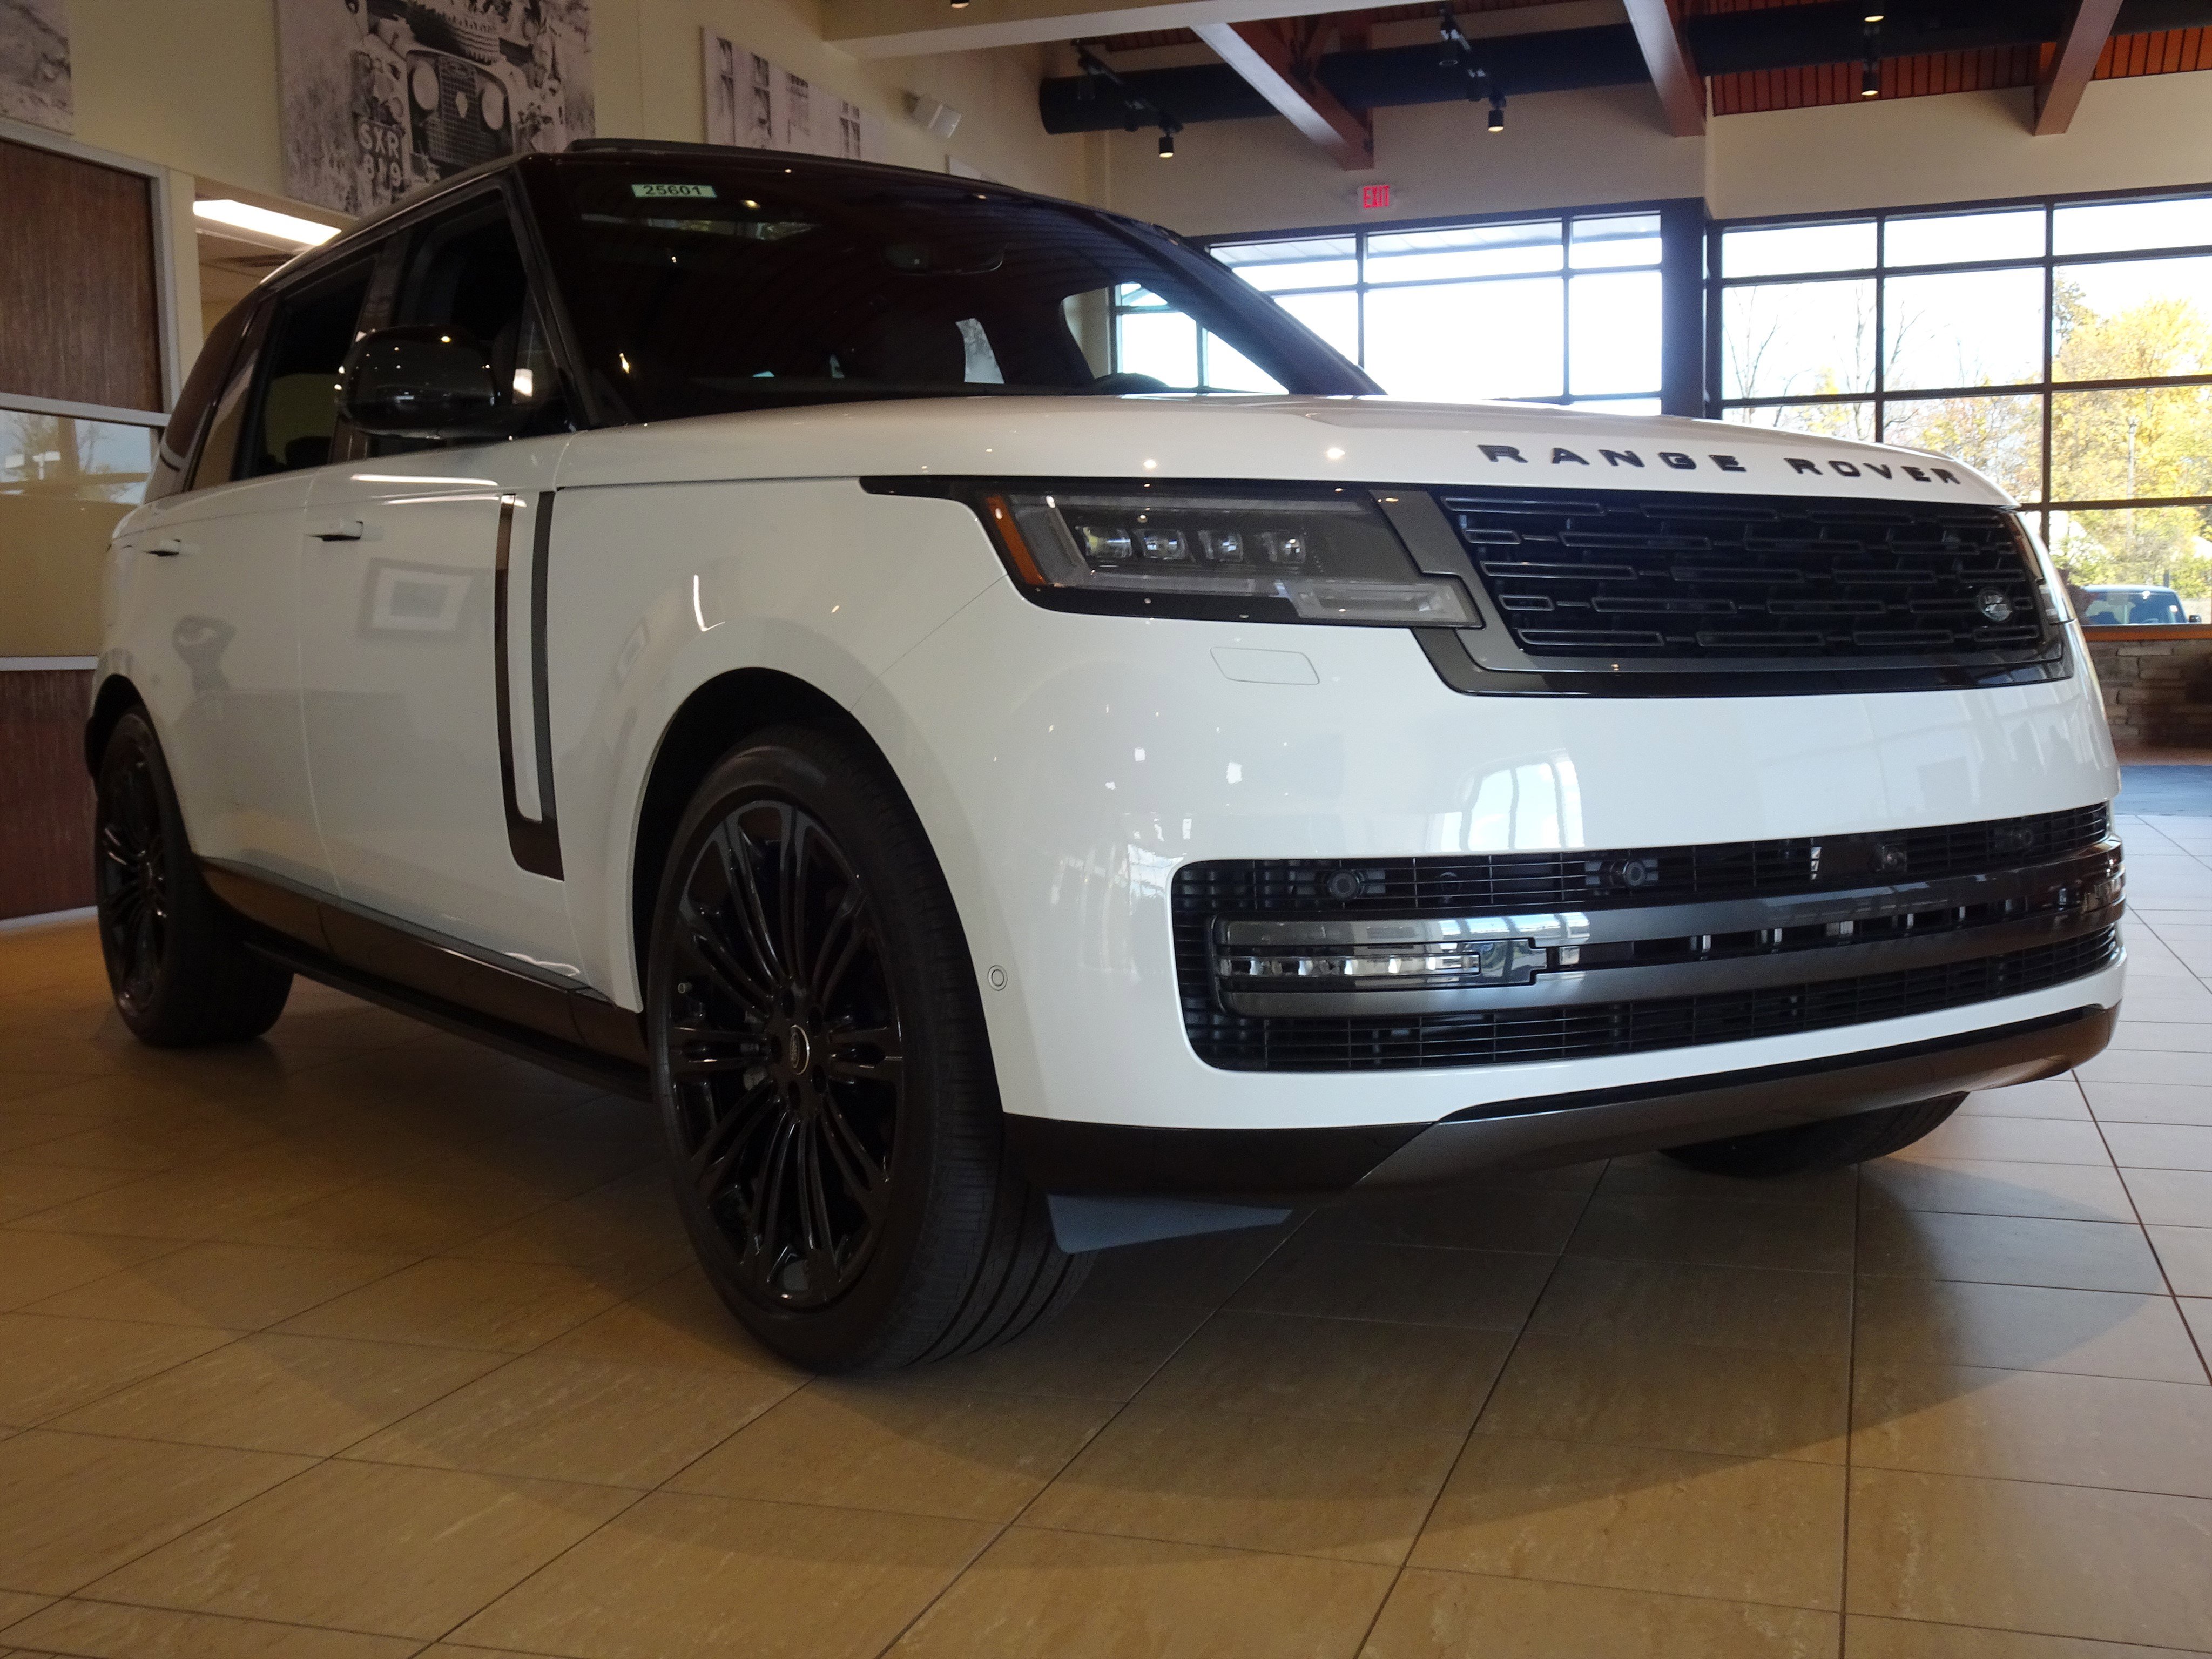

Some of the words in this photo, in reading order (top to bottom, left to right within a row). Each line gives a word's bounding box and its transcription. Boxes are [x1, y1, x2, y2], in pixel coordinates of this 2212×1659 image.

[643, 185, 701, 195] 25601
[1363, 185, 1390, 208] EXIT
[1478, 445, 1746, 472] RANGE
[1784, 458, 1960, 484] ROVER
